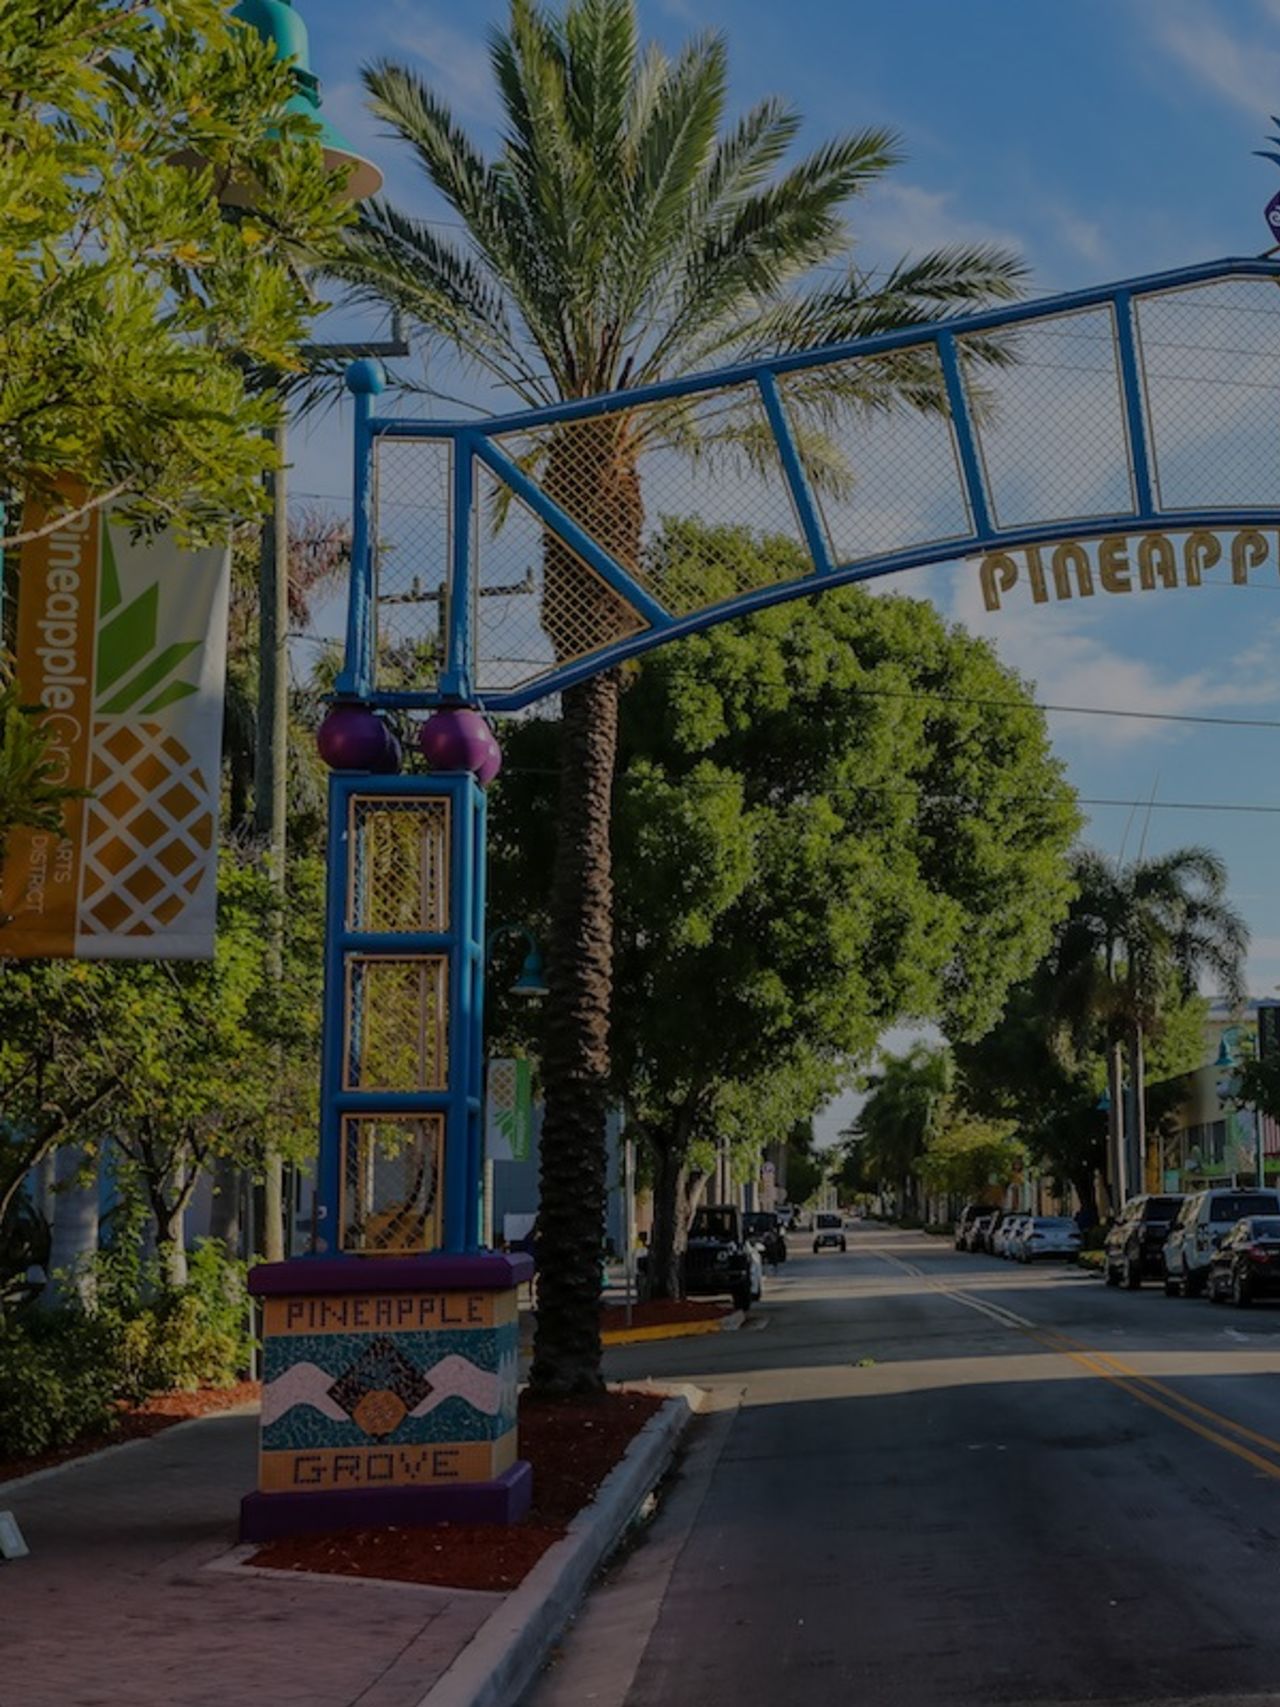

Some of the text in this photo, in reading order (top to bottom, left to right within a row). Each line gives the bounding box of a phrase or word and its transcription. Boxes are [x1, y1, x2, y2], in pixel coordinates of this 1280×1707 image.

[25, 835, 49, 914] DISTRICT
[287, 1296, 484, 1329] PINEAPPLE
[293, 1450, 460, 1484] GROVE
